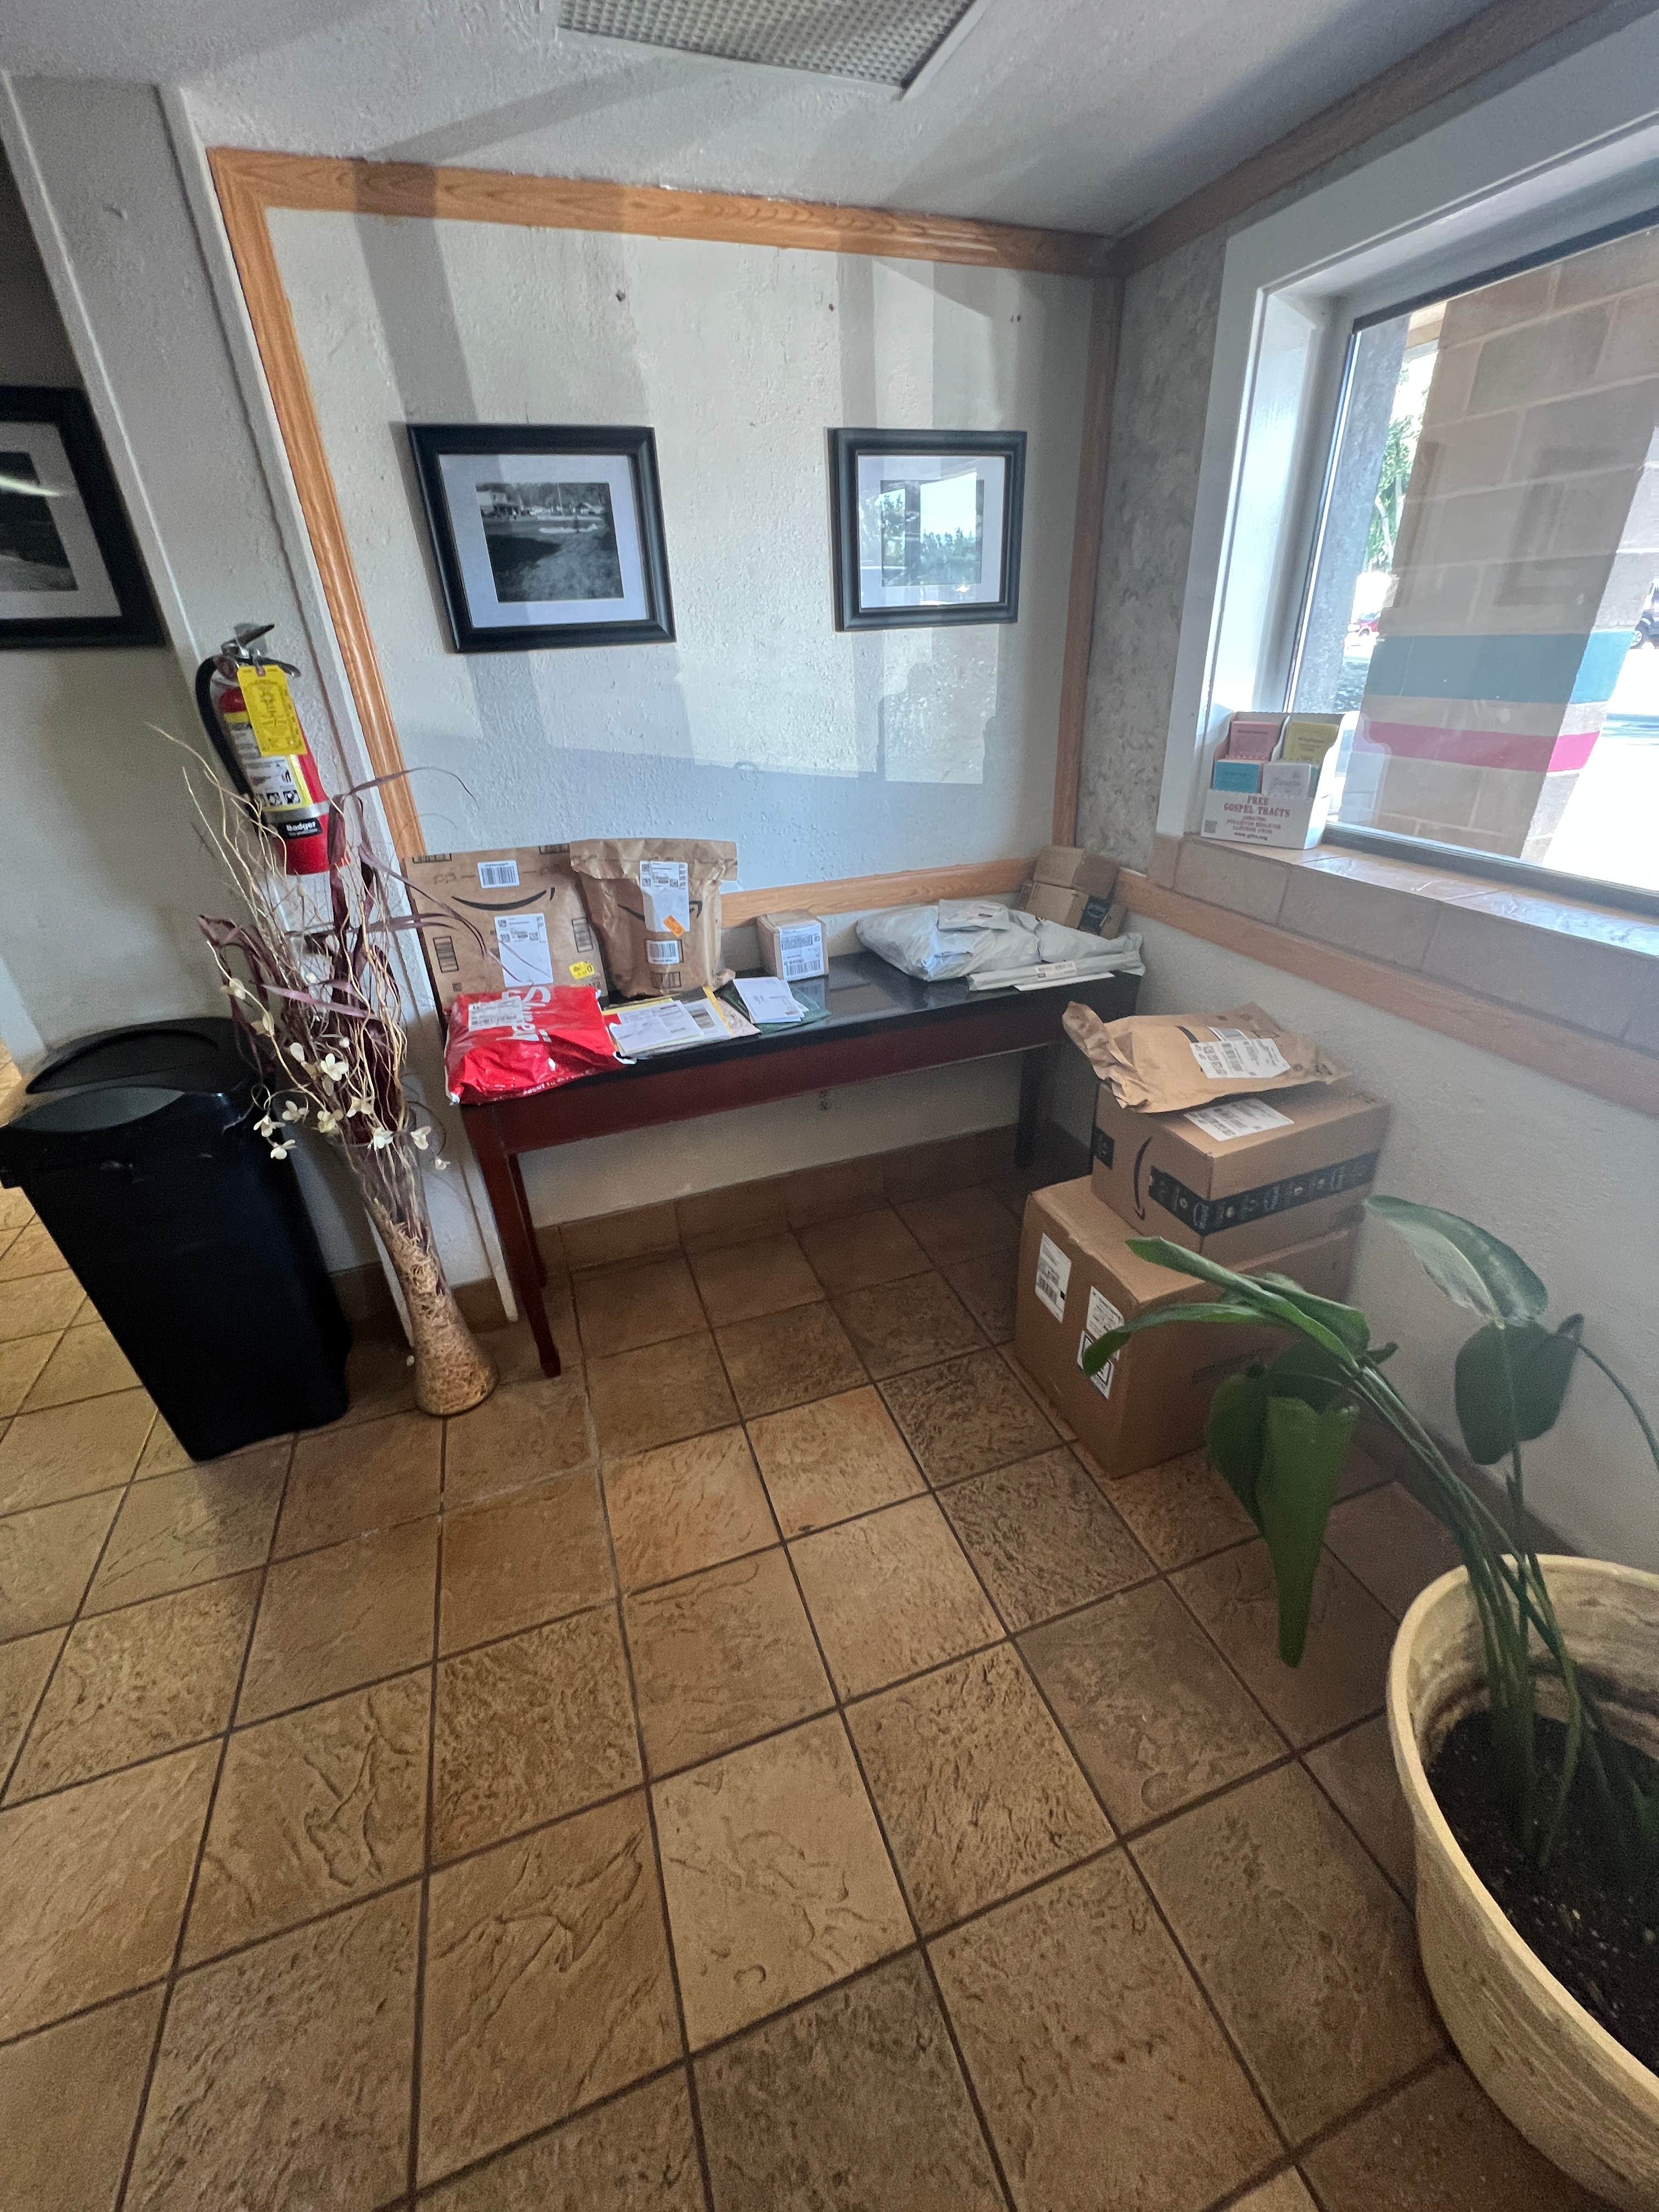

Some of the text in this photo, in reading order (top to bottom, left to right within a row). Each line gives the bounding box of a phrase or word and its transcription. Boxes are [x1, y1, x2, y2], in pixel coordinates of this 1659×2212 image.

[1247, 796, 1269, 806] FREE
[1224, 803, 1290, 817] GOSPEL TRACTS
[286, 821, 316, 831] Badger
